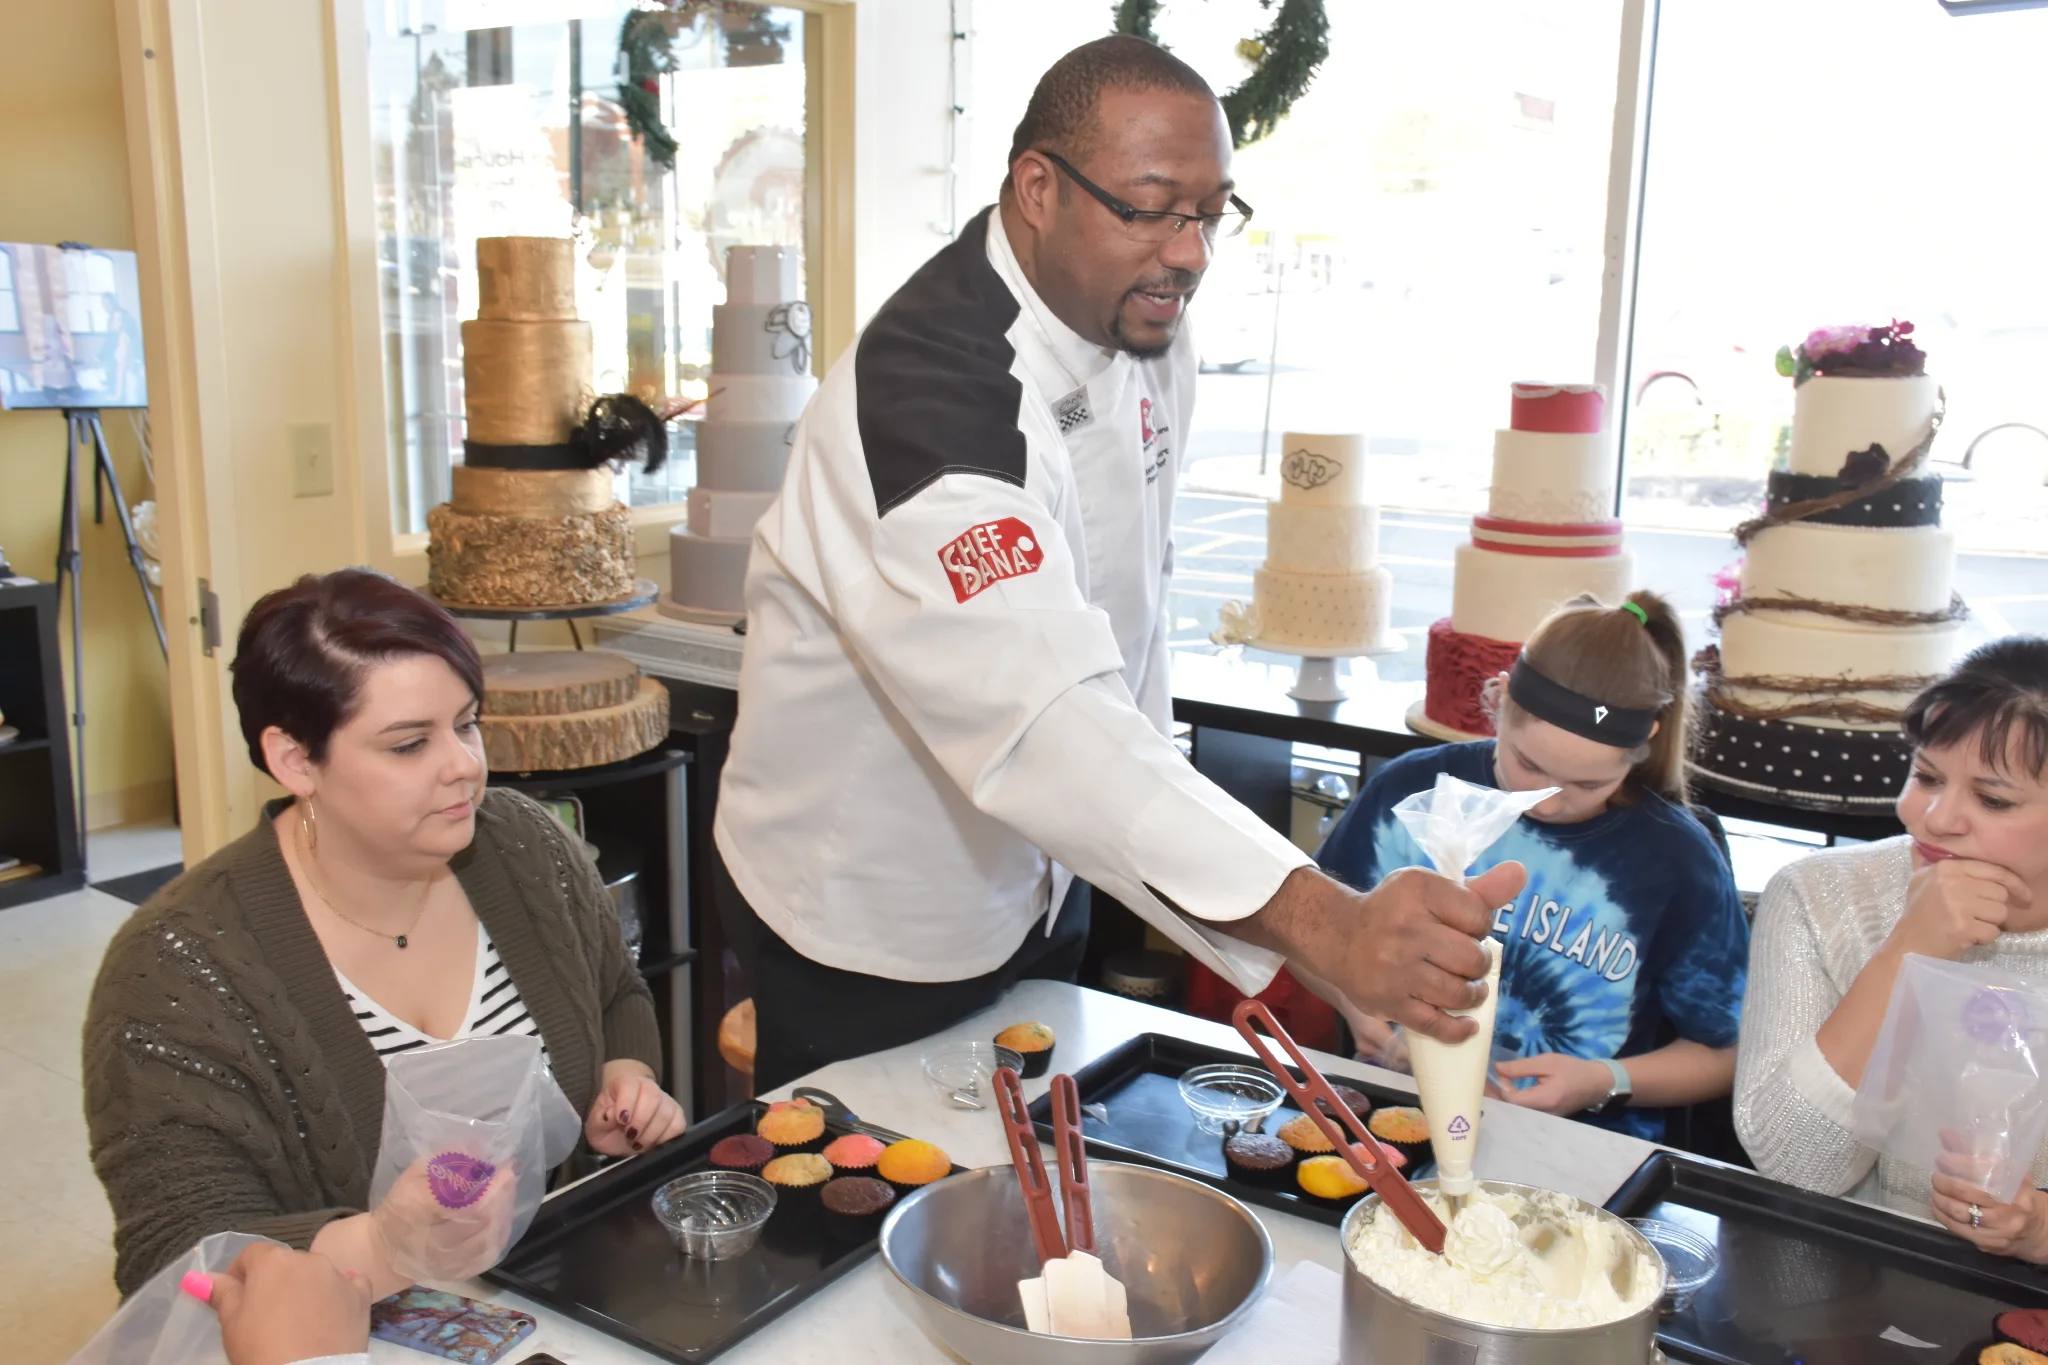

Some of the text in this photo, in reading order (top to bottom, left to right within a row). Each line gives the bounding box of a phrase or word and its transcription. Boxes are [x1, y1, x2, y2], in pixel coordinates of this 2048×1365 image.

[943, 523, 1003, 573] CHEF
[957, 544, 1032, 595] DANA
[1520, 894, 1638, 983] ISLAND
